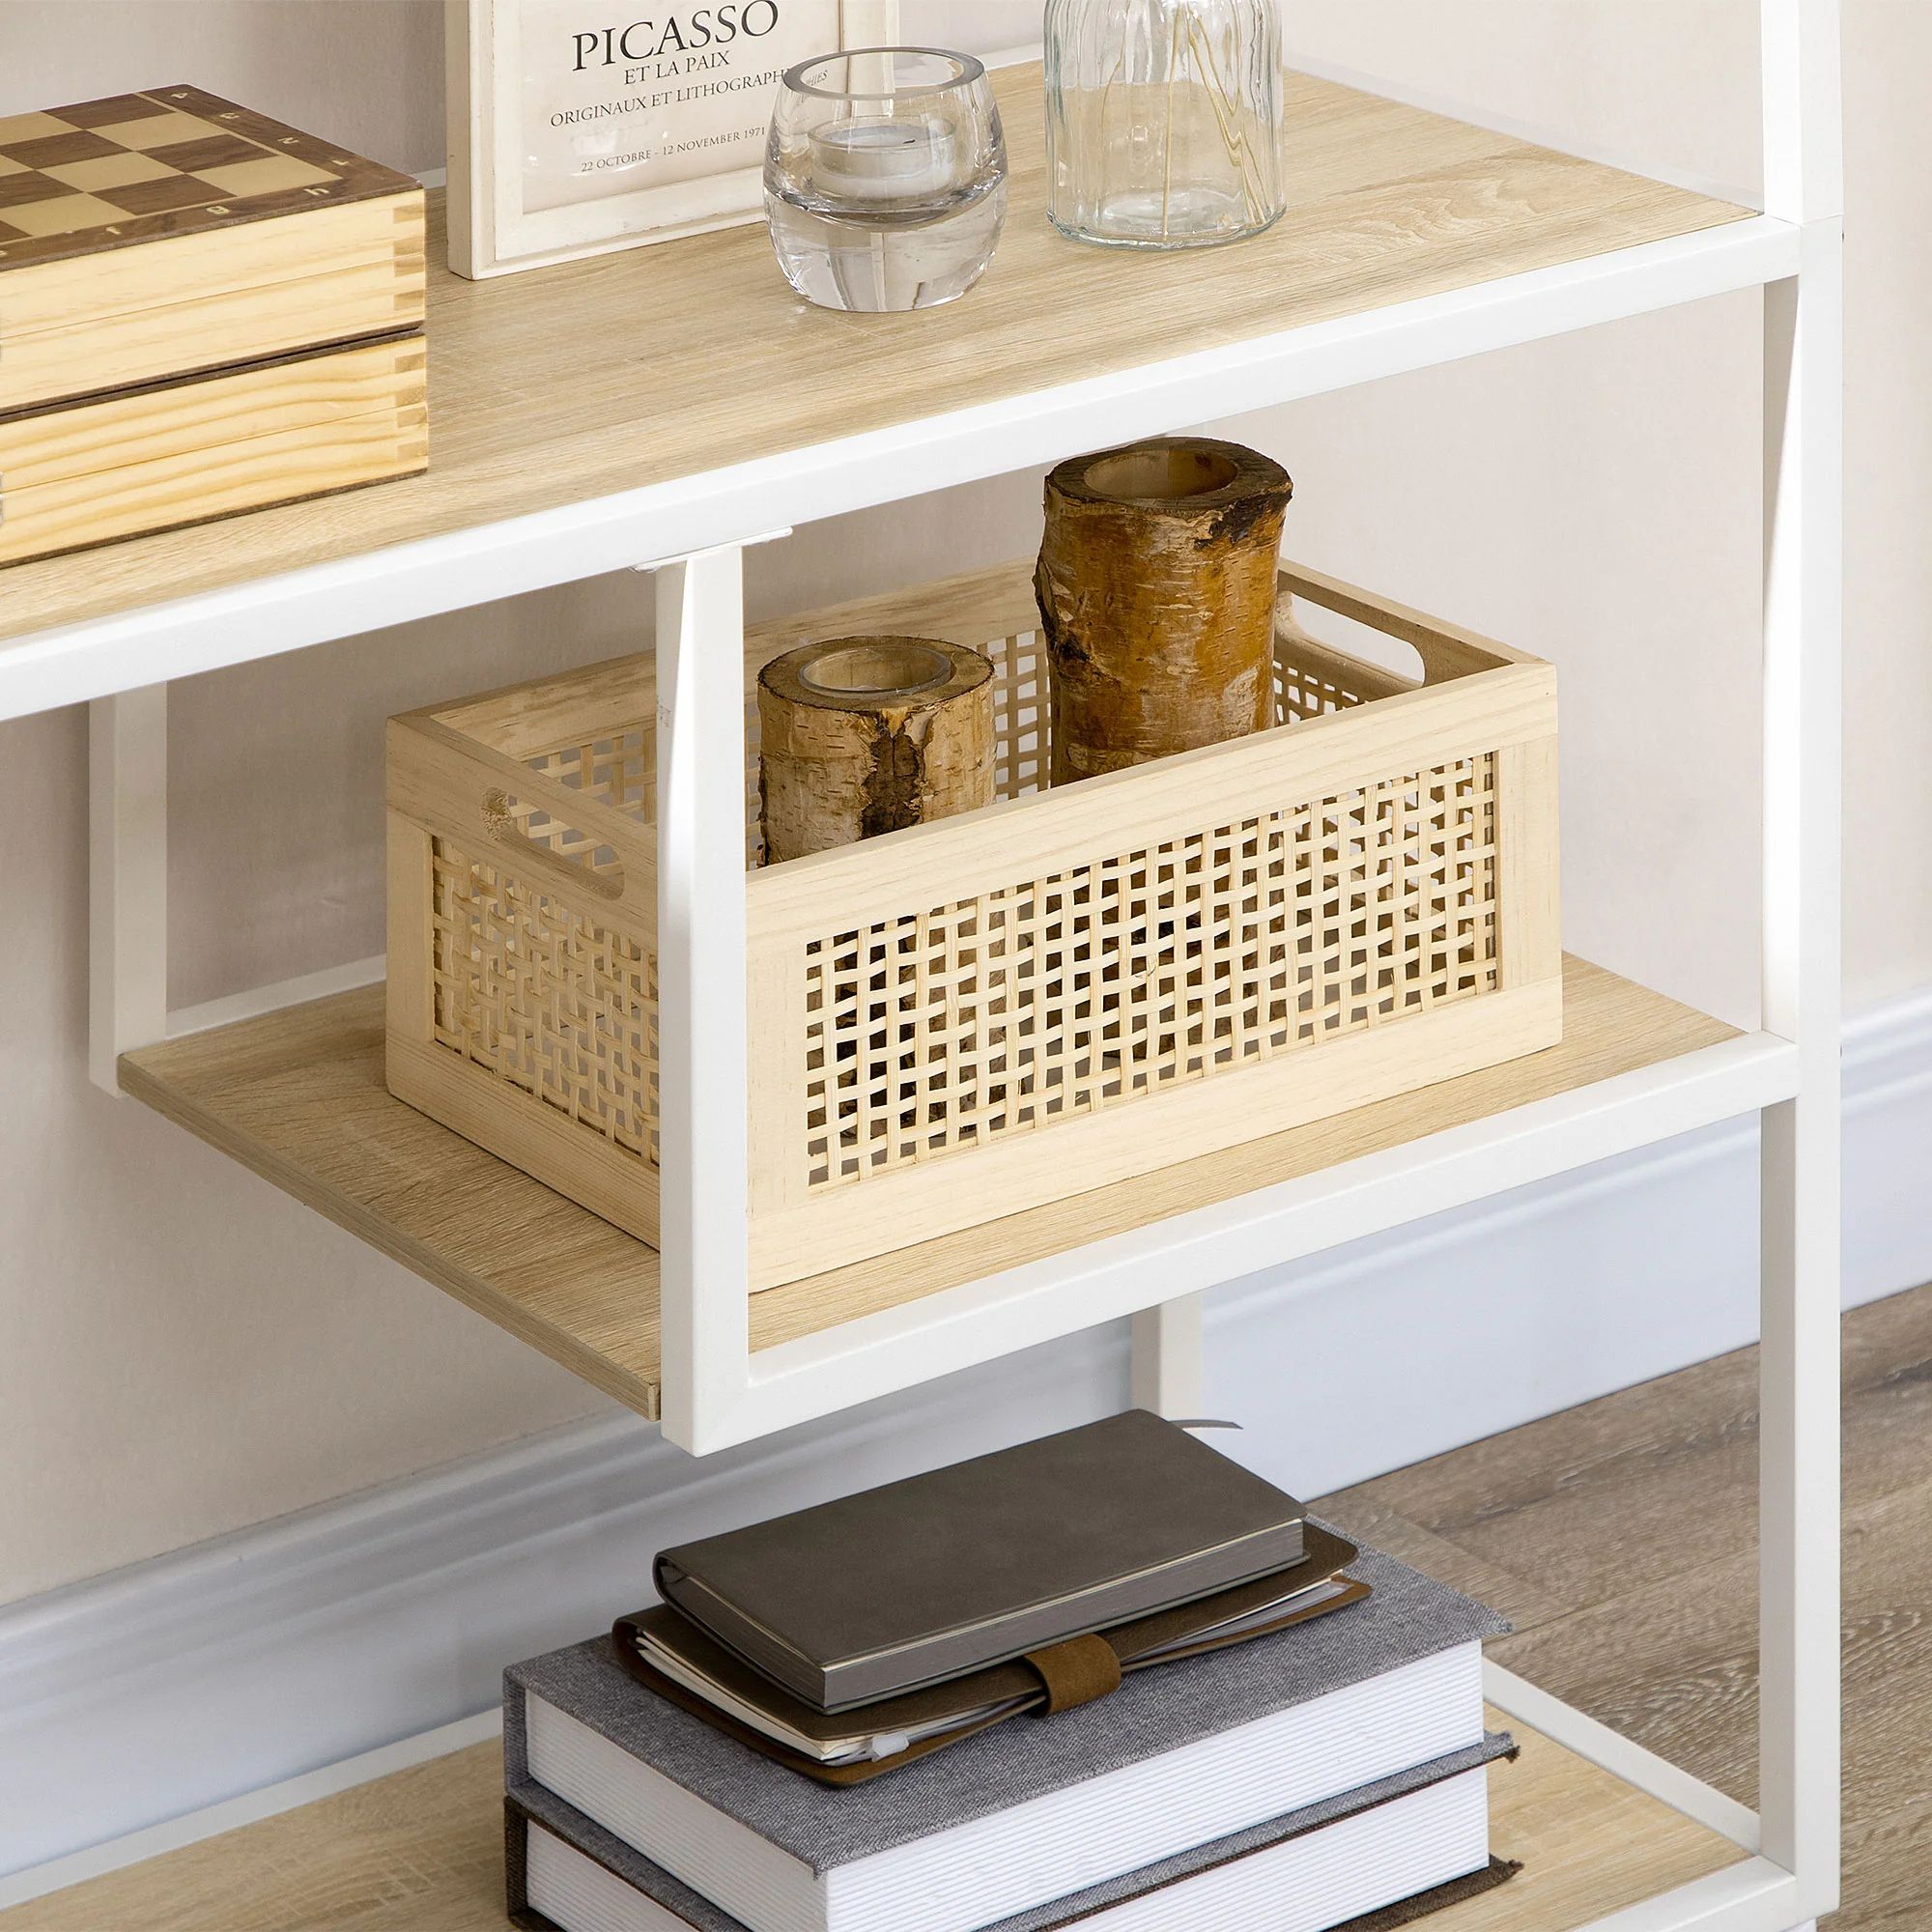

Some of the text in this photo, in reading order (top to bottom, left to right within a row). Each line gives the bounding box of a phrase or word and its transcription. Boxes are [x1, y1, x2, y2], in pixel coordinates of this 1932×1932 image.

[572, 0, 779, 71] PICASSO
[624, 49, 731, 85] ET LA PAIX
[550, 96, 647, 128] ORIGINAUX
[651, 91, 673, 107] ET
[581, 160, 594, 172] 22
[596, 149, 651, 169] OCTOBRE
[662, 145, 674, 156] 12
[676, 131, 741, 153] NOVEMBER
[744, 126, 766, 139] 1971
